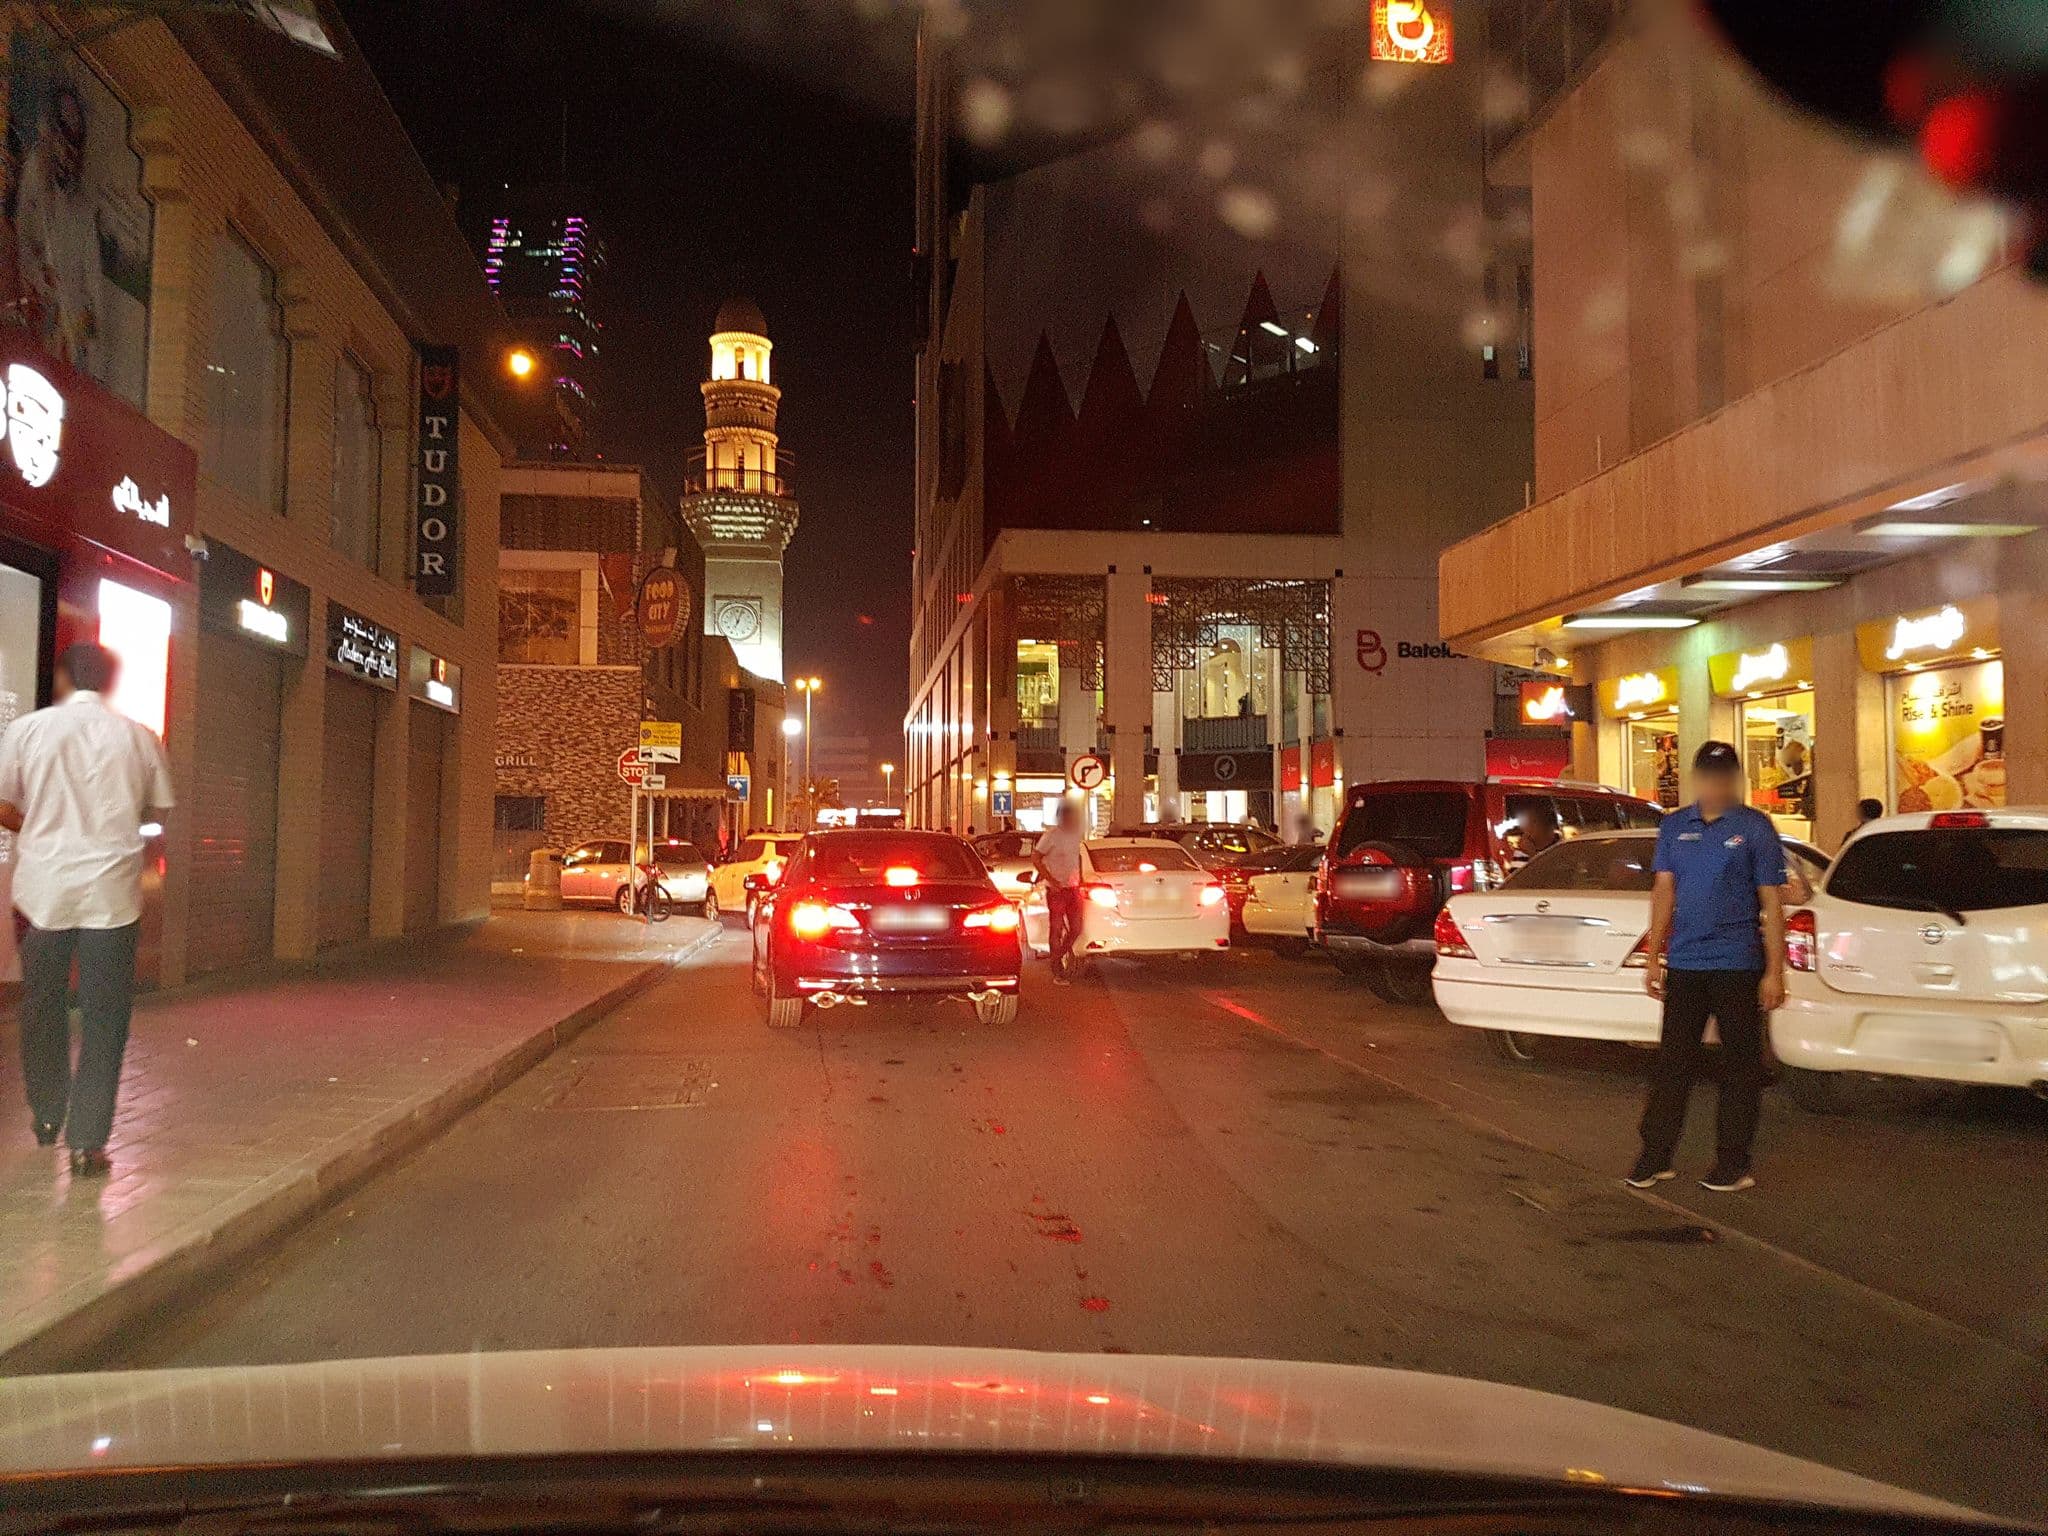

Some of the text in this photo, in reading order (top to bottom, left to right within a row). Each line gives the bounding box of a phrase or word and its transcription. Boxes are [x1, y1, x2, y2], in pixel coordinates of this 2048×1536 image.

[421, 416, 448, 575] TUDOR
[648, 601, 671, 620] CITY
[1397, 641, 1469, 658] Batel
[1941, 700, 1973, 717] Shine
[494, 755, 537, 767] GRILL
